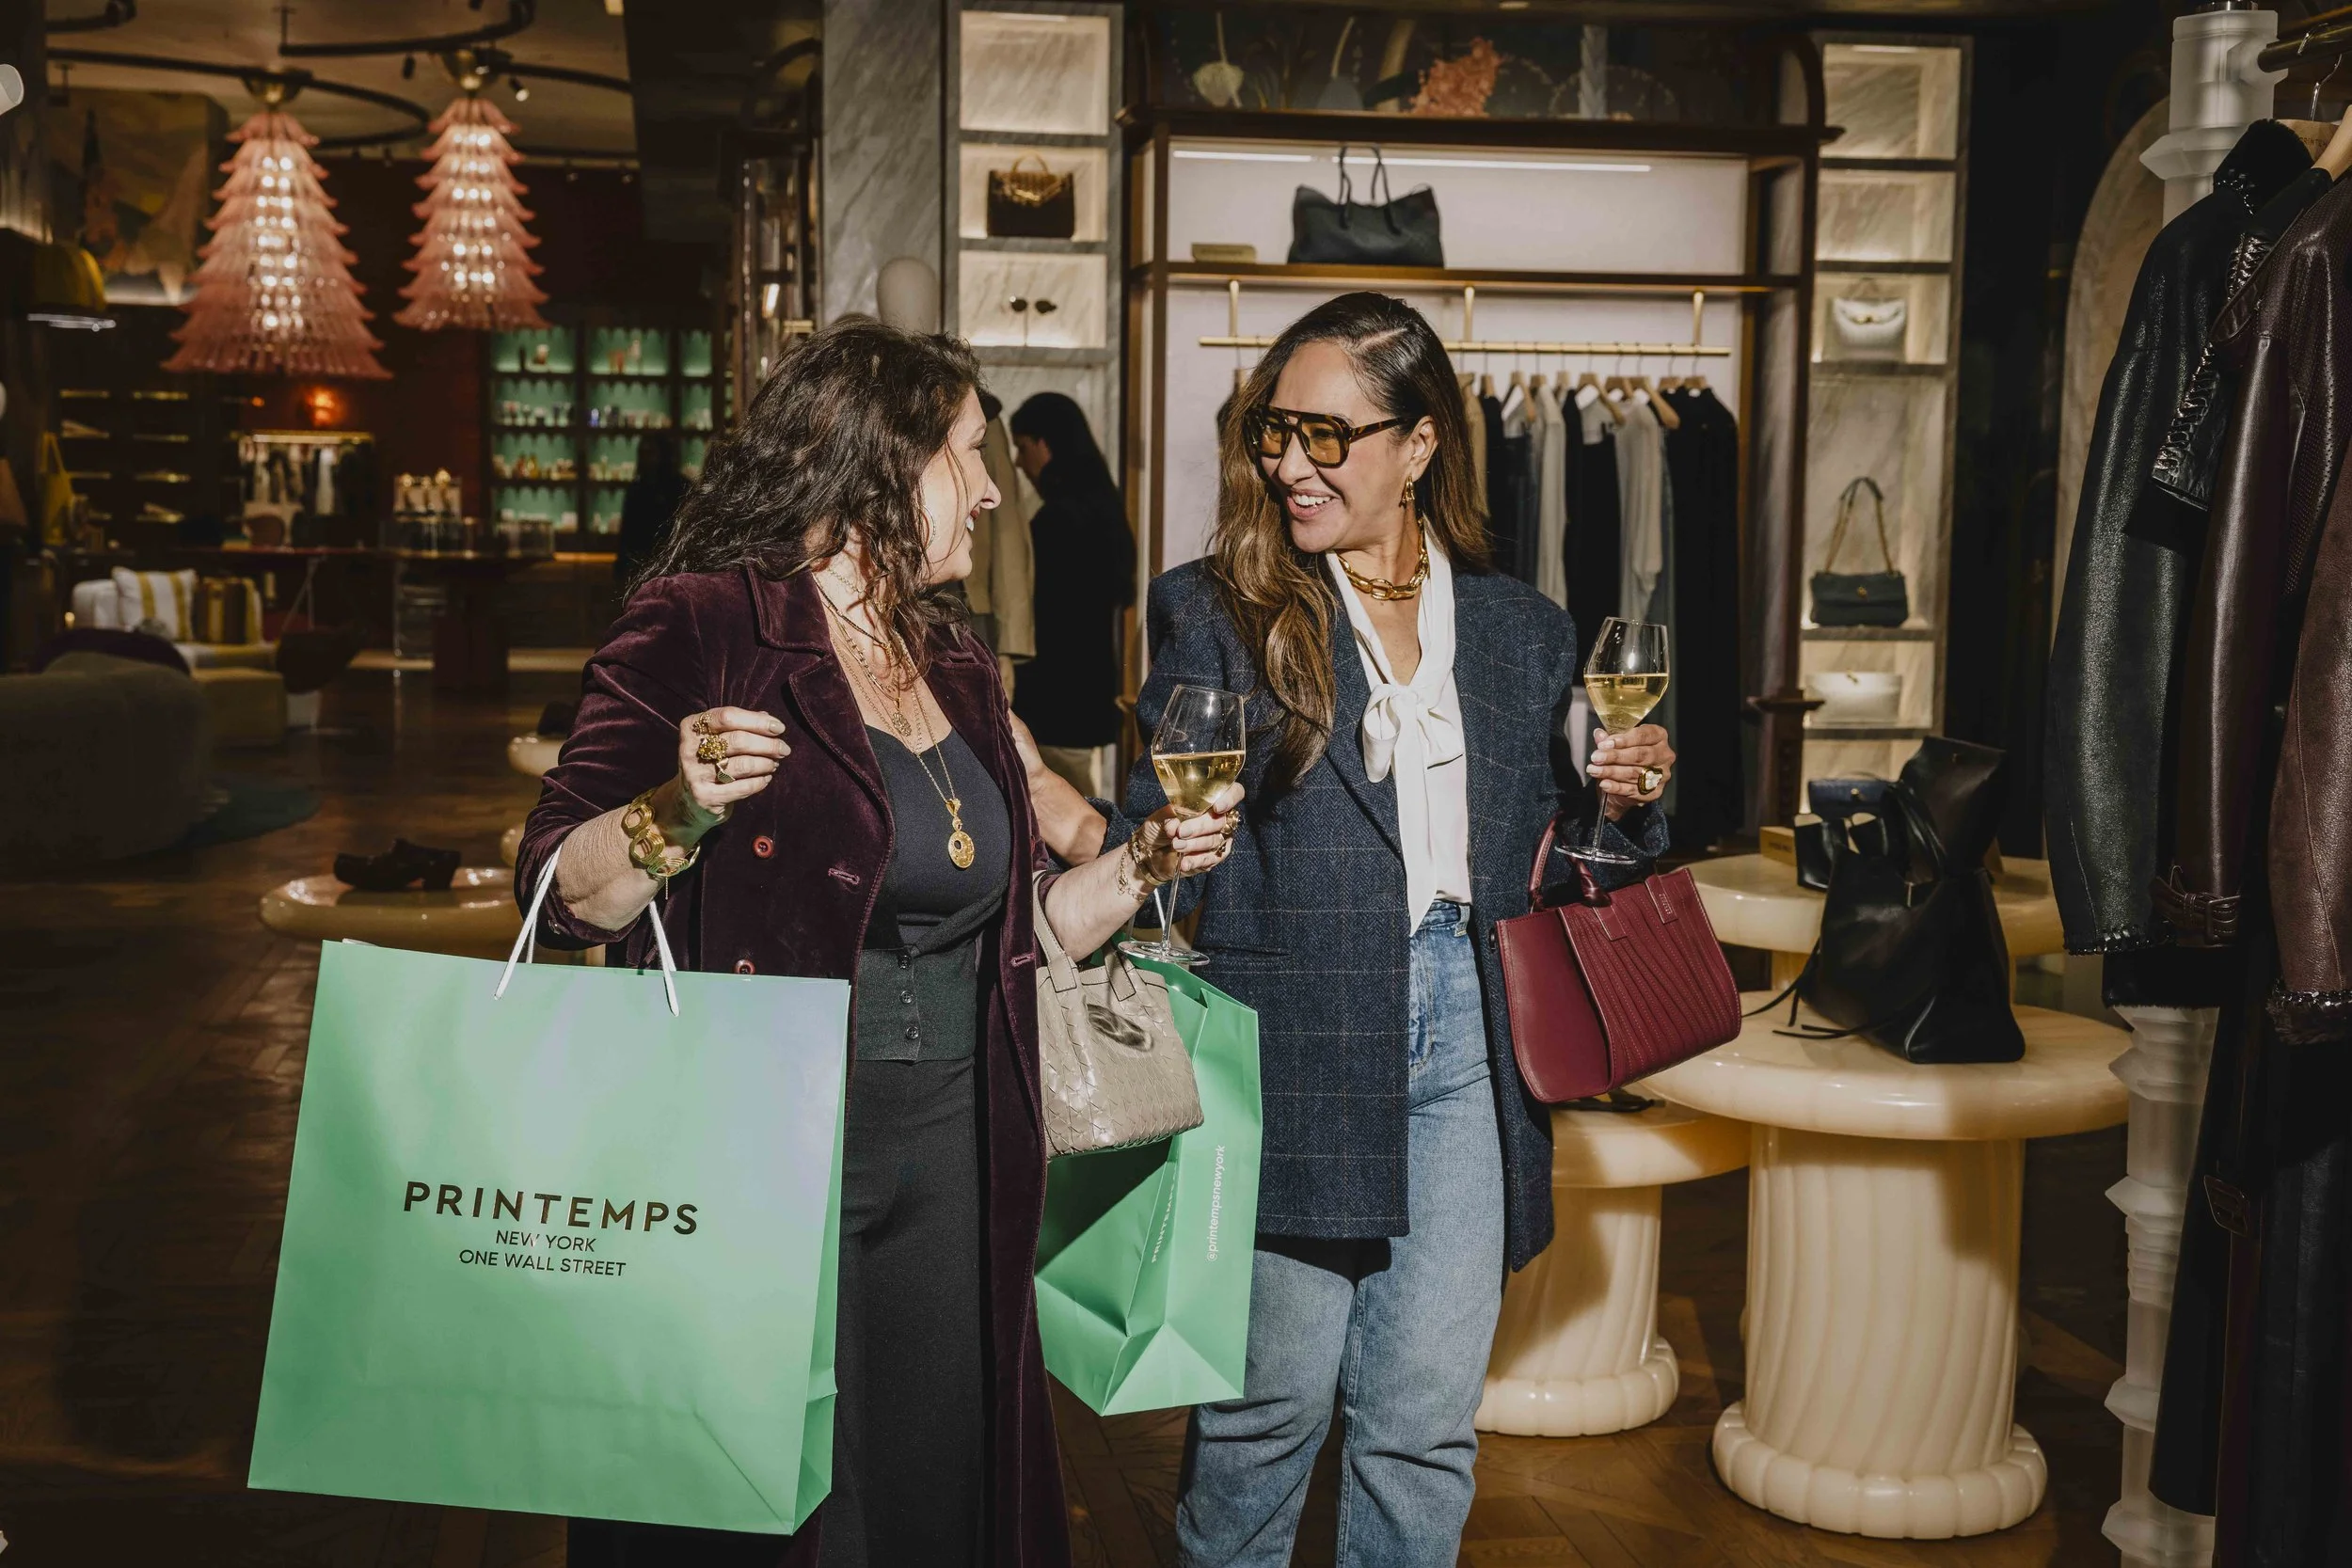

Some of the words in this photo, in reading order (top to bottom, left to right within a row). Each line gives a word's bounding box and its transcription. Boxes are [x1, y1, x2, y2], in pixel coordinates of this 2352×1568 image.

[404, 1180, 699, 1236] PRINTEMPS
[1207, 1145, 1226, 1261] @printempsnewyork
[496, 1229, 540, 1247] NEW
[546, 1234, 596, 1253] YORK
[458, 1249, 499, 1267] ONE
[504, 1253, 555, 1272] WALL
[560, 1258, 627, 1276] STREET
